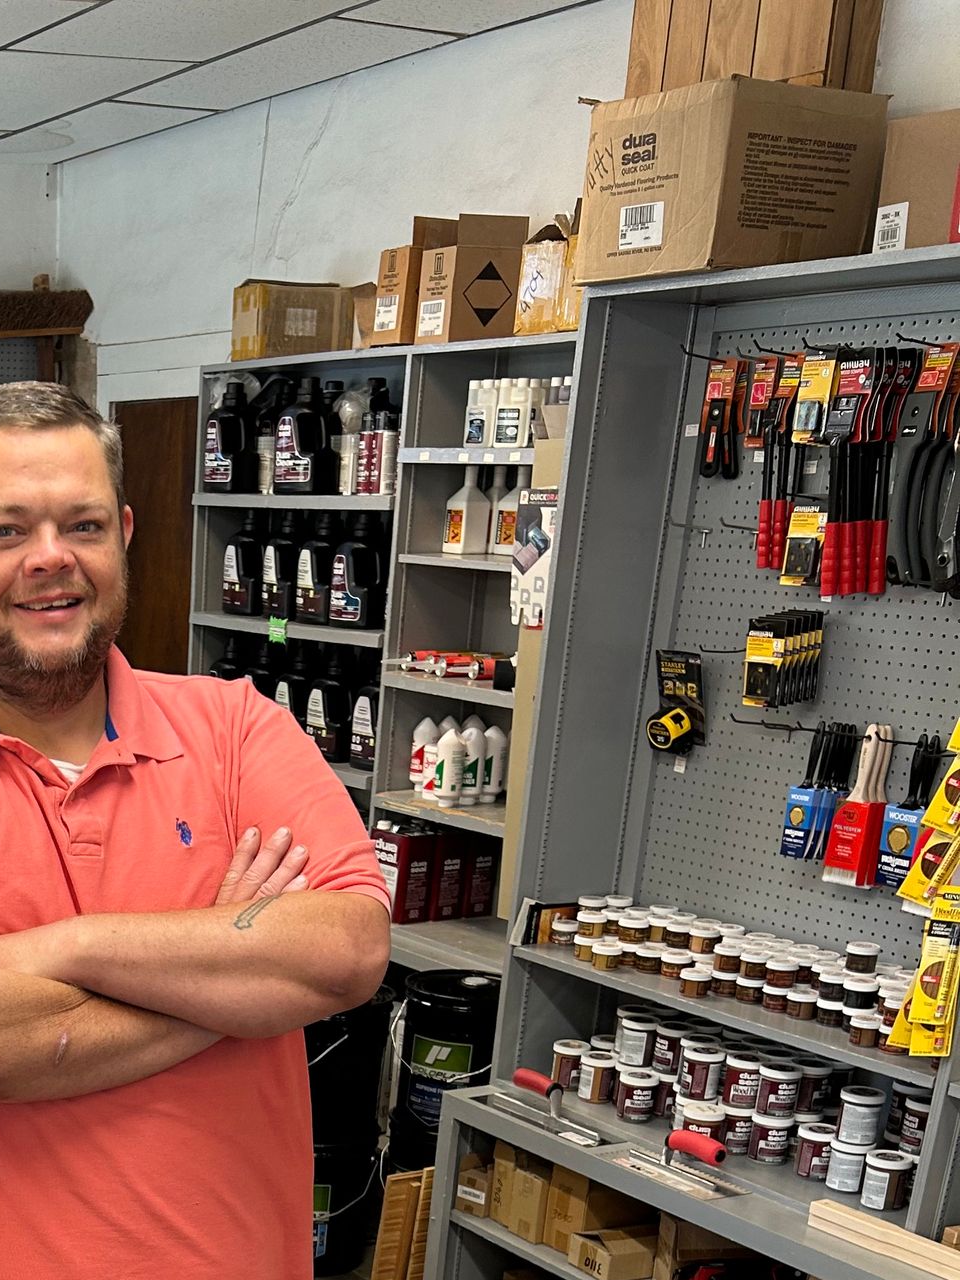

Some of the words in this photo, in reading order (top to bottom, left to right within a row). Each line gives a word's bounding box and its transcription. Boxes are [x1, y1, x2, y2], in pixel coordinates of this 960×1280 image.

[622, 132, 657, 150] dura
[747, 132, 783, 142] IMPORTANT
[787, 137, 813, 146] INSPECT
[813, 139, 826, 148] FOR
[826, 141, 857, 151] DAMAGES
[621, 145, 657, 166] seal
[621, 165, 638, 176] QUICK
[639, 163, 655, 173] COAT
[600, 183, 614, 192] Quality
[637, 177, 655, 186] Flooring
[656, 173, 679, 182] Products
[661, 661, 686, 669] STANLEY
[889, 811, 918, 824] WOOSTER
[375, 838, 398, 852] dura
[412, 1064, 468, 1081] POLOPLA
